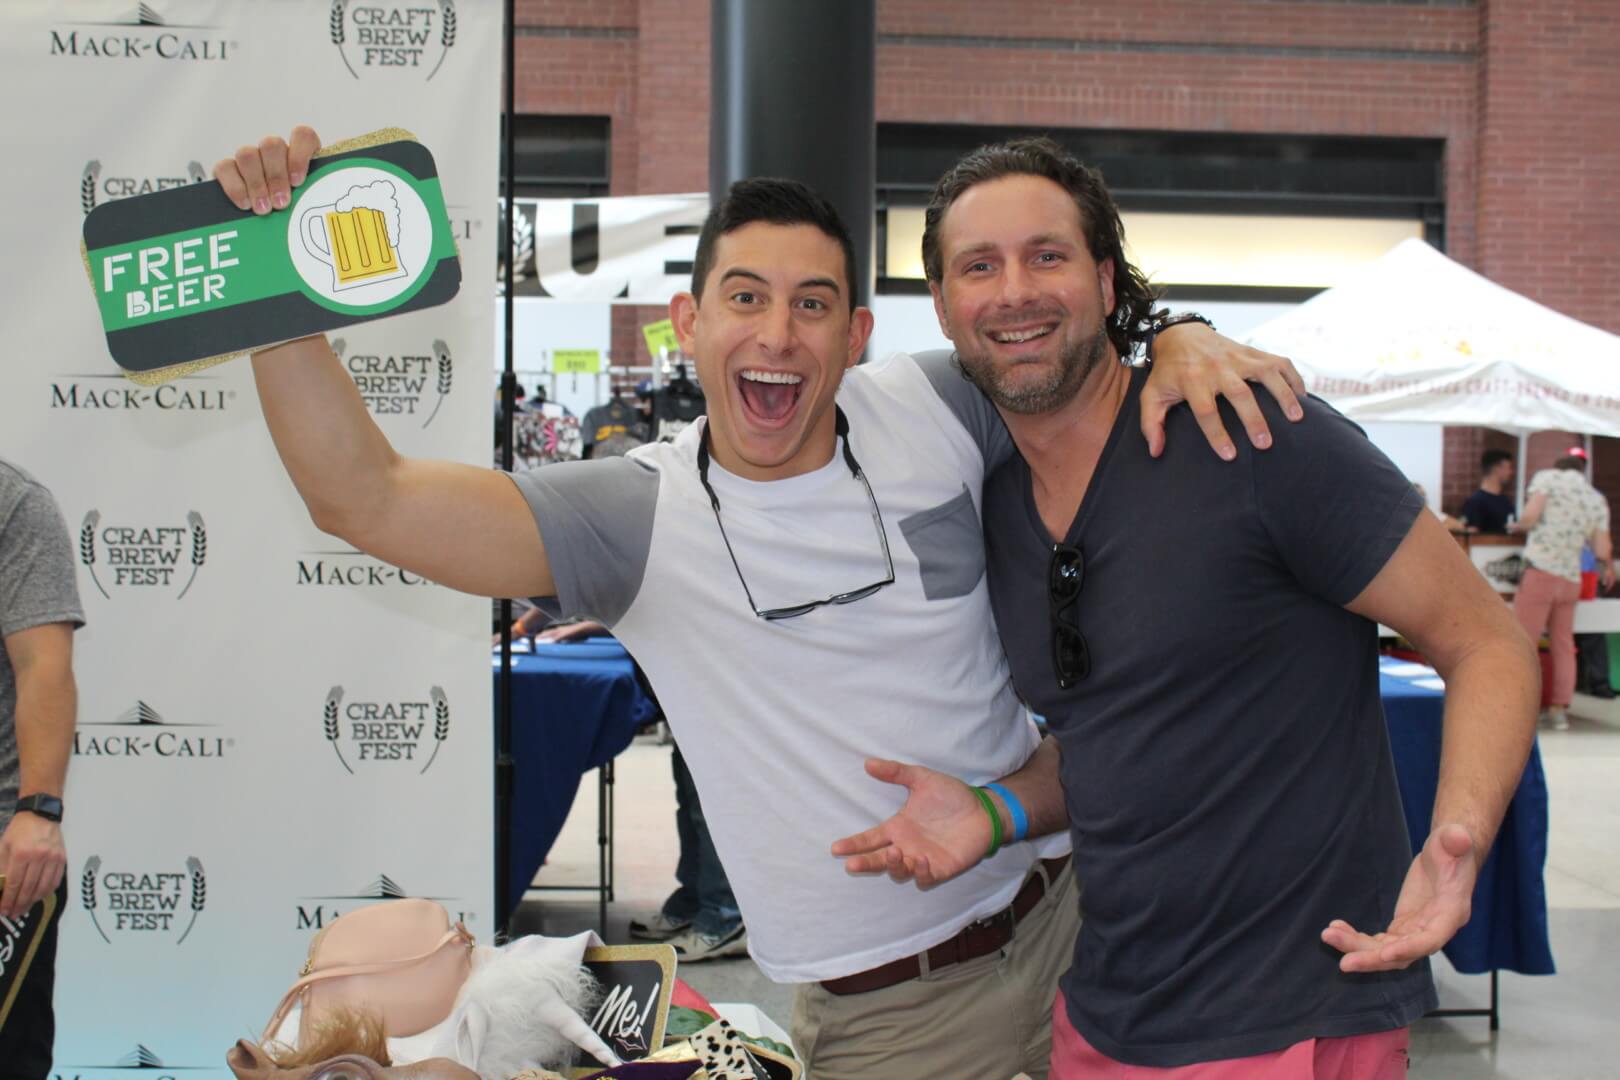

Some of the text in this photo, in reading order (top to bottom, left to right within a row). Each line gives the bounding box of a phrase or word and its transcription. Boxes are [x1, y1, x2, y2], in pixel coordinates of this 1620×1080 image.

[352, 7, 436, 27] CRAFT
[50, 30, 227, 60] MACK-CALI
[357, 28, 431, 47] BREW
[364, 48, 424, 67] FEST
[103, 230, 240, 293] FREE
[126, 273, 226, 319] BEER
[348, 355, 432, 374] CRAFT
[353, 376, 427, 394] BREW
[50, 384, 225, 411] MACK-CALI
[102, 527, 187, 546] CRAFT
[107, 547, 182, 566] BREW
[115, 567, 175, 586] FEST
[297, 560, 440, 586] MACK-C
[346, 702, 430, 721] CRAFT
[352, 722, 425, 741] BREW
[358, 742, 418, 761] FEST
[103, 872, 187, 891] CRAFT
[109, 892, 181, 911] BREW
[115, 912, 174, 931] FEST
[589, 982, 660, 1038] Me!
